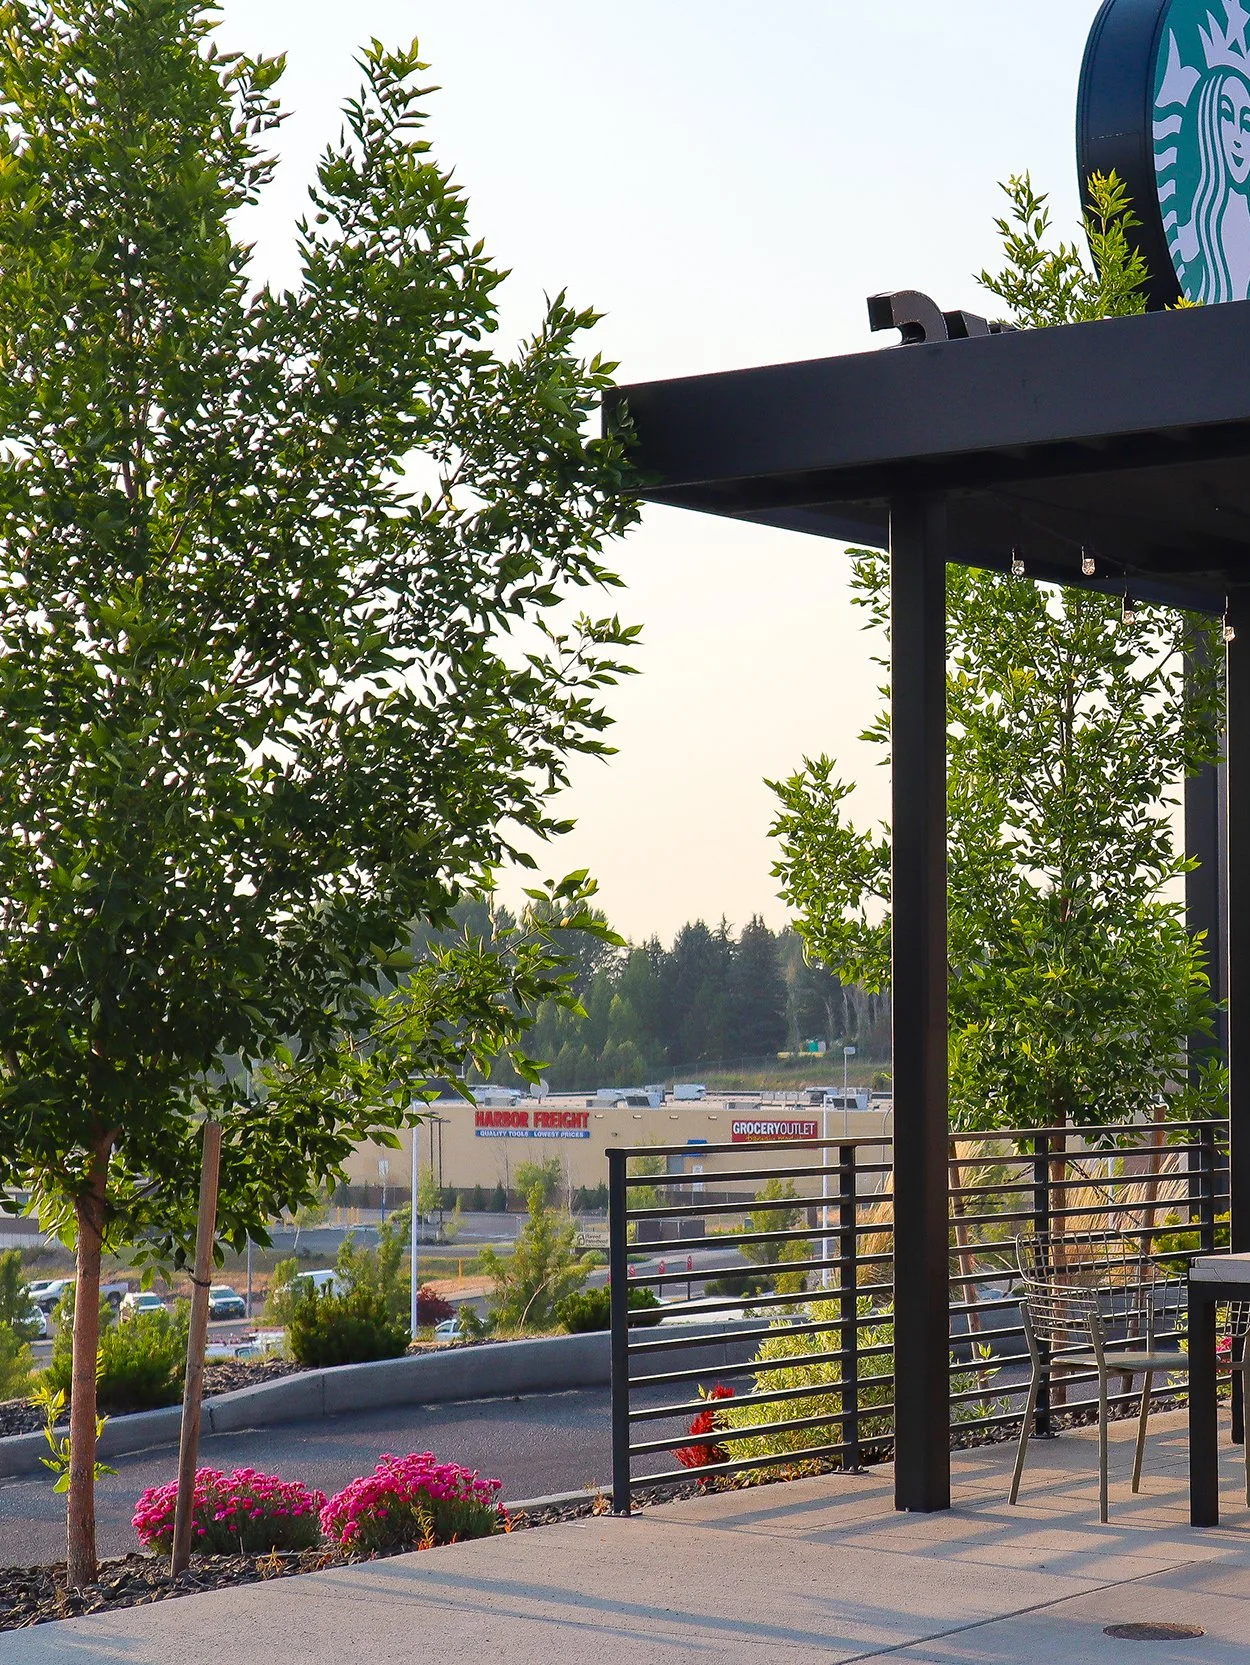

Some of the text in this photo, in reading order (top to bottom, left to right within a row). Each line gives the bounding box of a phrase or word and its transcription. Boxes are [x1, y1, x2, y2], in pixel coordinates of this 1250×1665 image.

[475, 1111, 590, 1128] HARBOR FREIGHT
[480, 1130, 584, 1139] QUALITY TOOLS LOWEST PRICES
